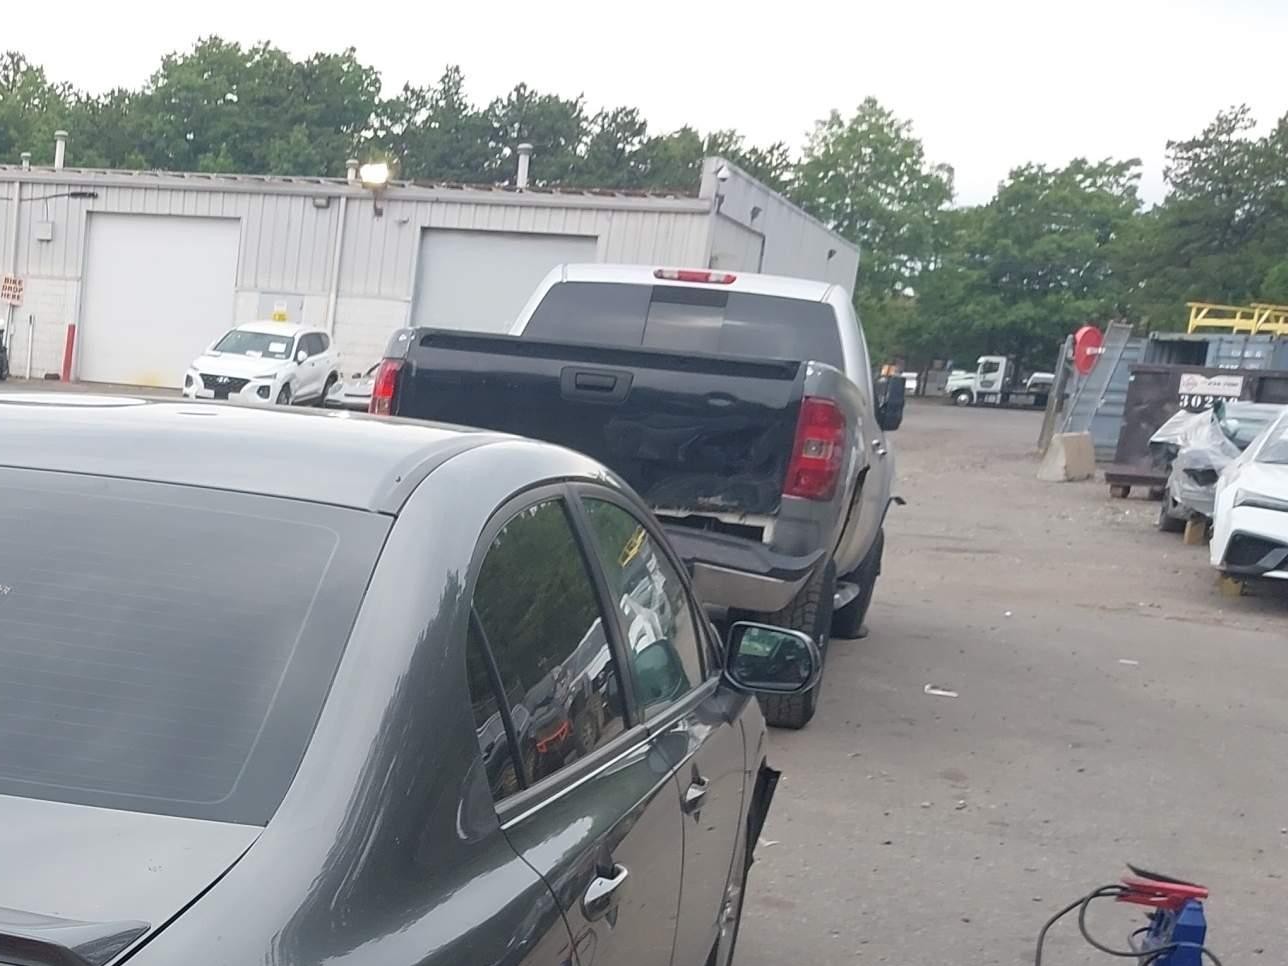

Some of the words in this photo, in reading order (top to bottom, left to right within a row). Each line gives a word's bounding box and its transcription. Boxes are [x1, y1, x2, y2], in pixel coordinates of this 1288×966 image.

[4, 276, 23, 286] BIKE
[2, 284, 23, 293] DROP
[0, 291, 20, 300] HERE
